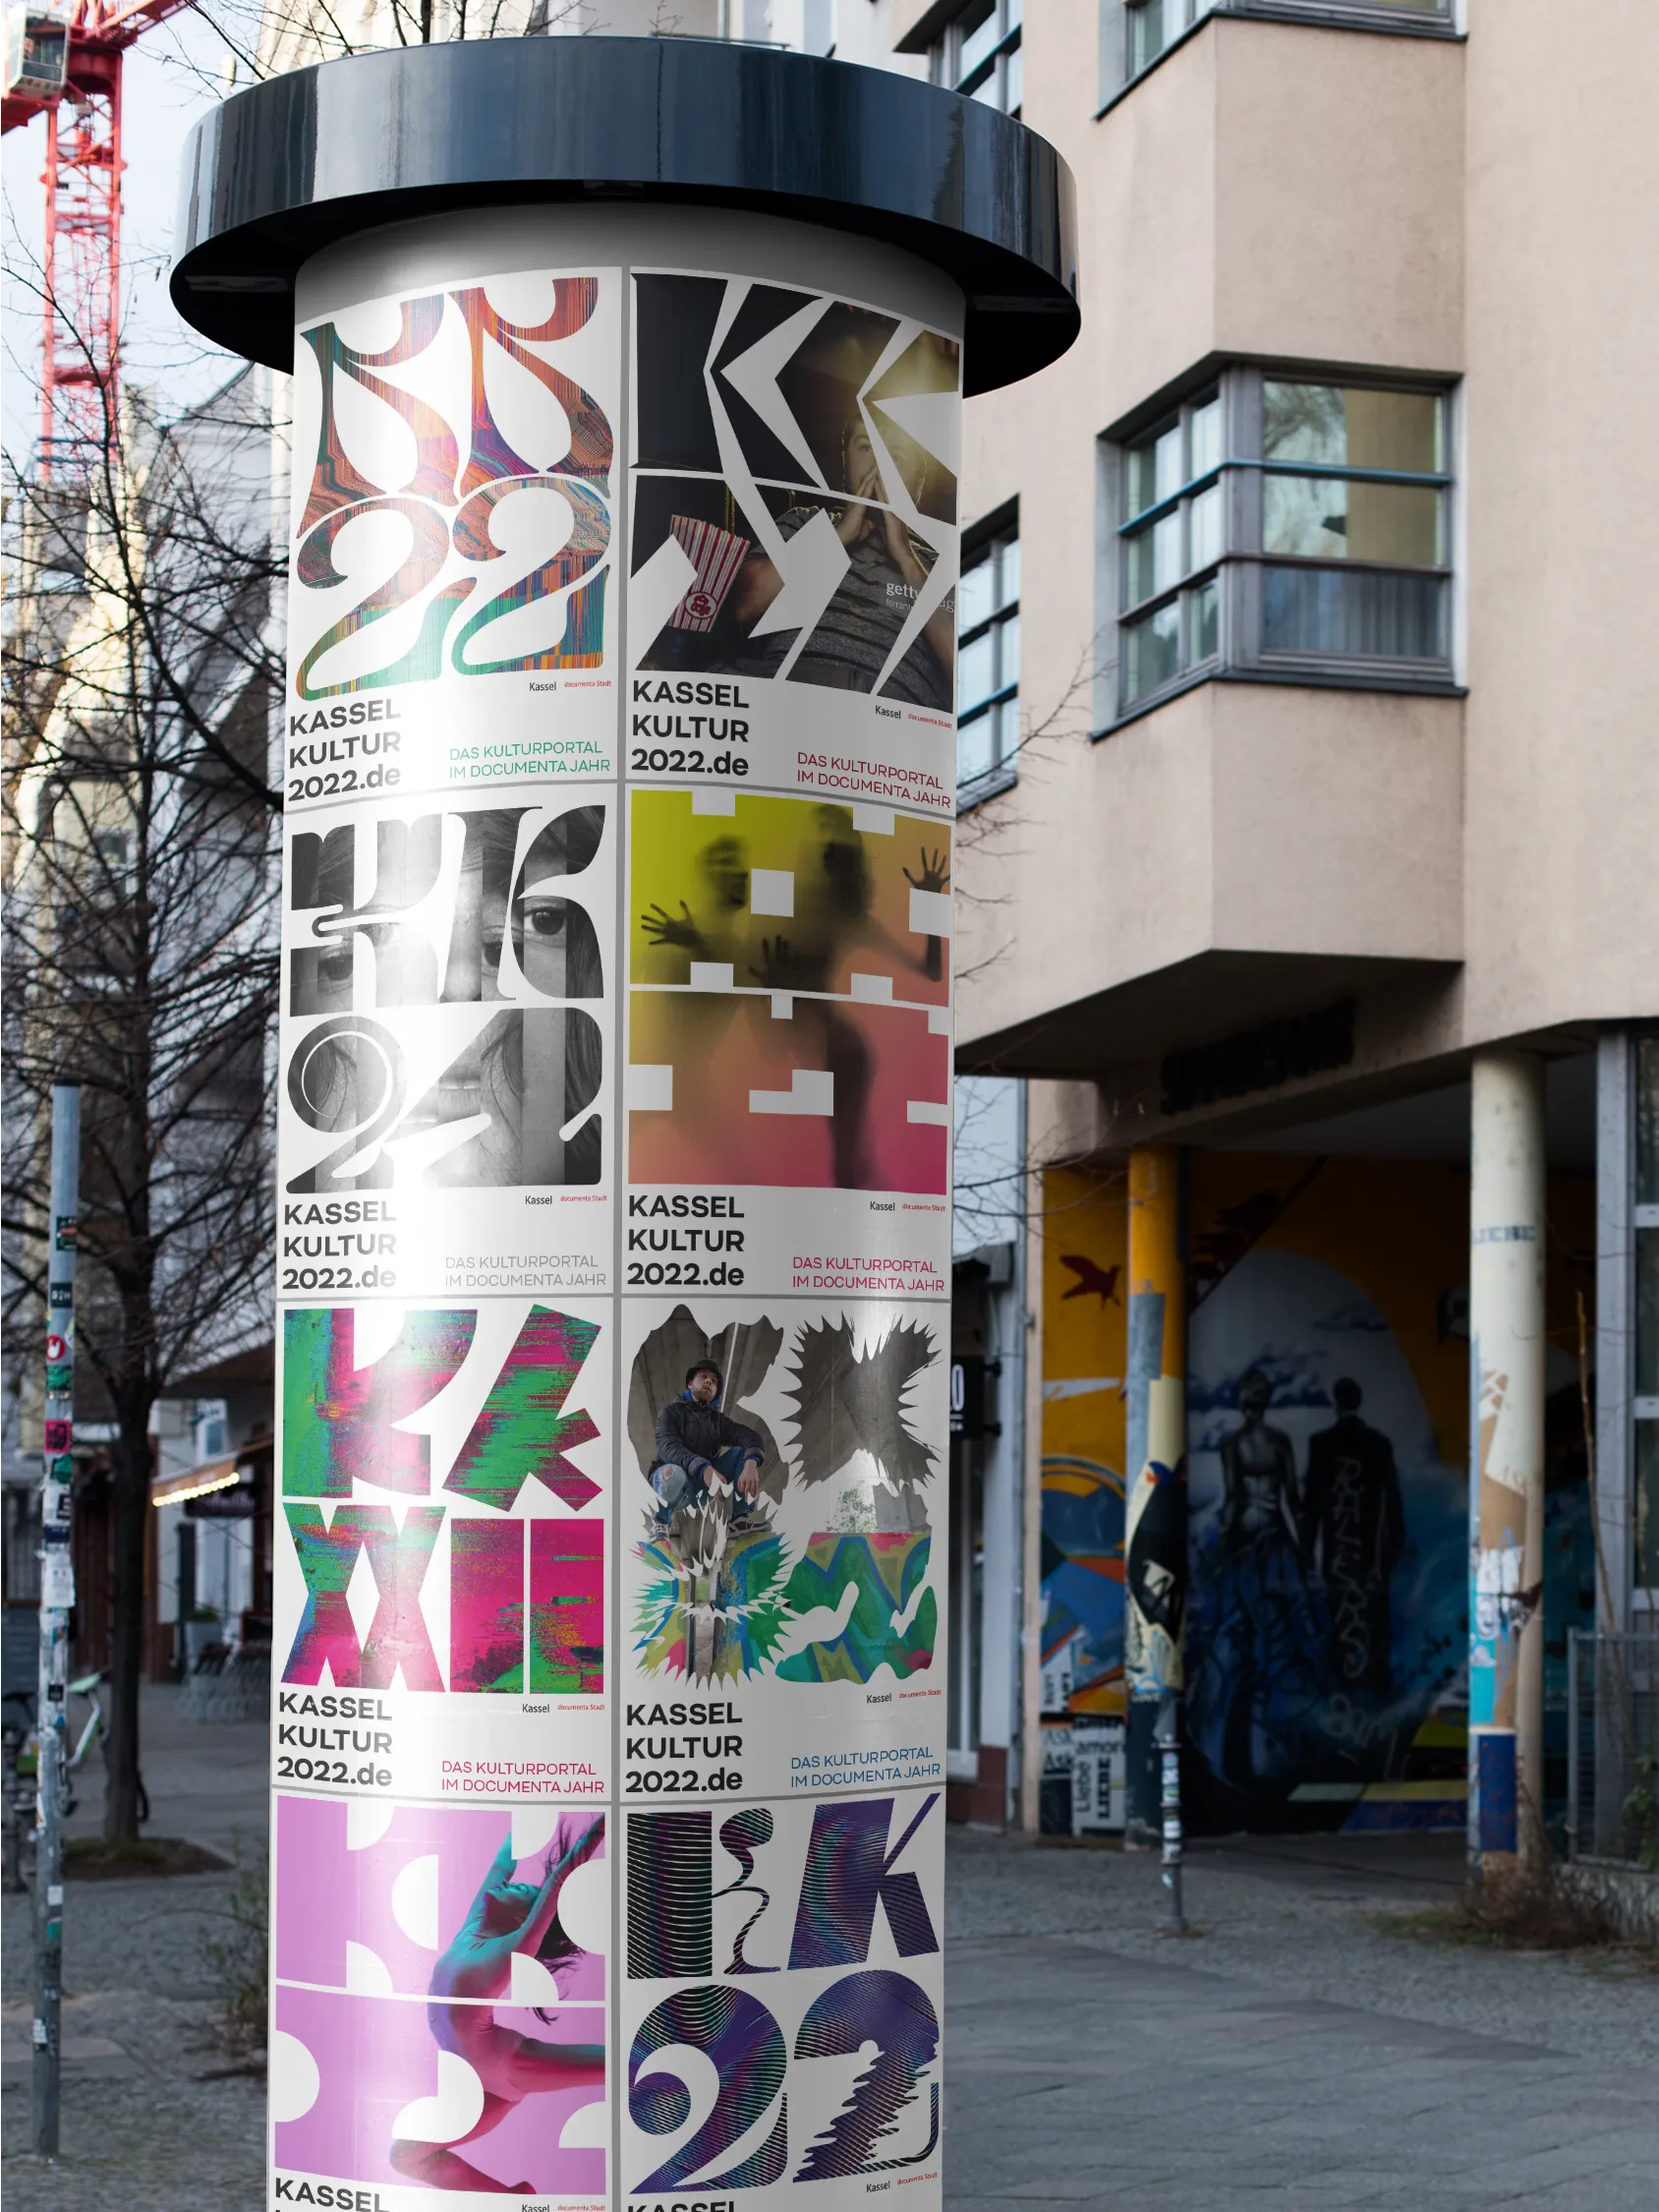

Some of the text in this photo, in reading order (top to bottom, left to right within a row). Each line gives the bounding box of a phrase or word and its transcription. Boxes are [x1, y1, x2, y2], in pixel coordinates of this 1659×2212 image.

[529, 681, 556, 692] Kassel
[633, 680, 749, 709] KASSEL
[290, 699, 400, 737] KASSEL
[633, 714, 749, 742] KULTUR
[876, 705, 951, 728] Kassel documenta Stadt
[289, 731, 400, 769] KULTUR
[450, 741, 603, 760] DAS KULTURPORTAL
[450, 759, 610, 779] IM DOCUMENTA JAHR
[631, 748, 749, 776] 2022.de
[798, 752, 944, 790] DAS KULTURPORTAL
[288, 764, 400, 802] 2022.de
[798, 770, 950, 808] IM DOCUMENTA JAHR
[525, 1195, 553, 1204] Kassel
[629, 1195, 745, 1218] KASSEL
[870, 1201, 895, 1211] Kassel
[284, 1201, 395, 1225] KASSEL
[283, 1234, 394, 1257] KULTUR
[629, 1229, 745, 1252] KULTUR
[446, 1255, 598, 1268] DAS KULTURPORTAL
[793, 1256, 938, 1274] DAS KULTURPORTAL
[282, 1265, 395, 1290] 2022.de
[446, 1273, 605, 1286] IM DOCUMENTA JAHR
[627, 1261, 744, 1286] 2022.de
[792, 1275, 944, 1292] IM DOCUMENTA JAHR
[279, 1692, 392, 1720] KASSEL
[523, 1704, 549, 1713] Kassel
[867, 1693, 891, 1704] Kassel
[627, 1702, 743, 1726] KASSEL
[279, 1724, 392, 1754] KULTUR
[627, 1735, 743, 1760] KULTUR
[442, 1761, 597, 1775] DAS KULTURPORTAL
[791, 1747, 934, 1770] DAS KULTURPORTAL
[277, 1756, 392, 1786] 2022.de
[625, 1767, 743, 1793] 2022.de
[791, 1764, 941, 1787] IM DOCUMENTA JAHR
[442, 1777, 604, 1793] IM DOCUMENTA JAHR
[275, 2177, 389, 2212] KASSEL
[867, 2181, 890, 2192] Kassel
[897, 2176, 924, 2184] documenta
